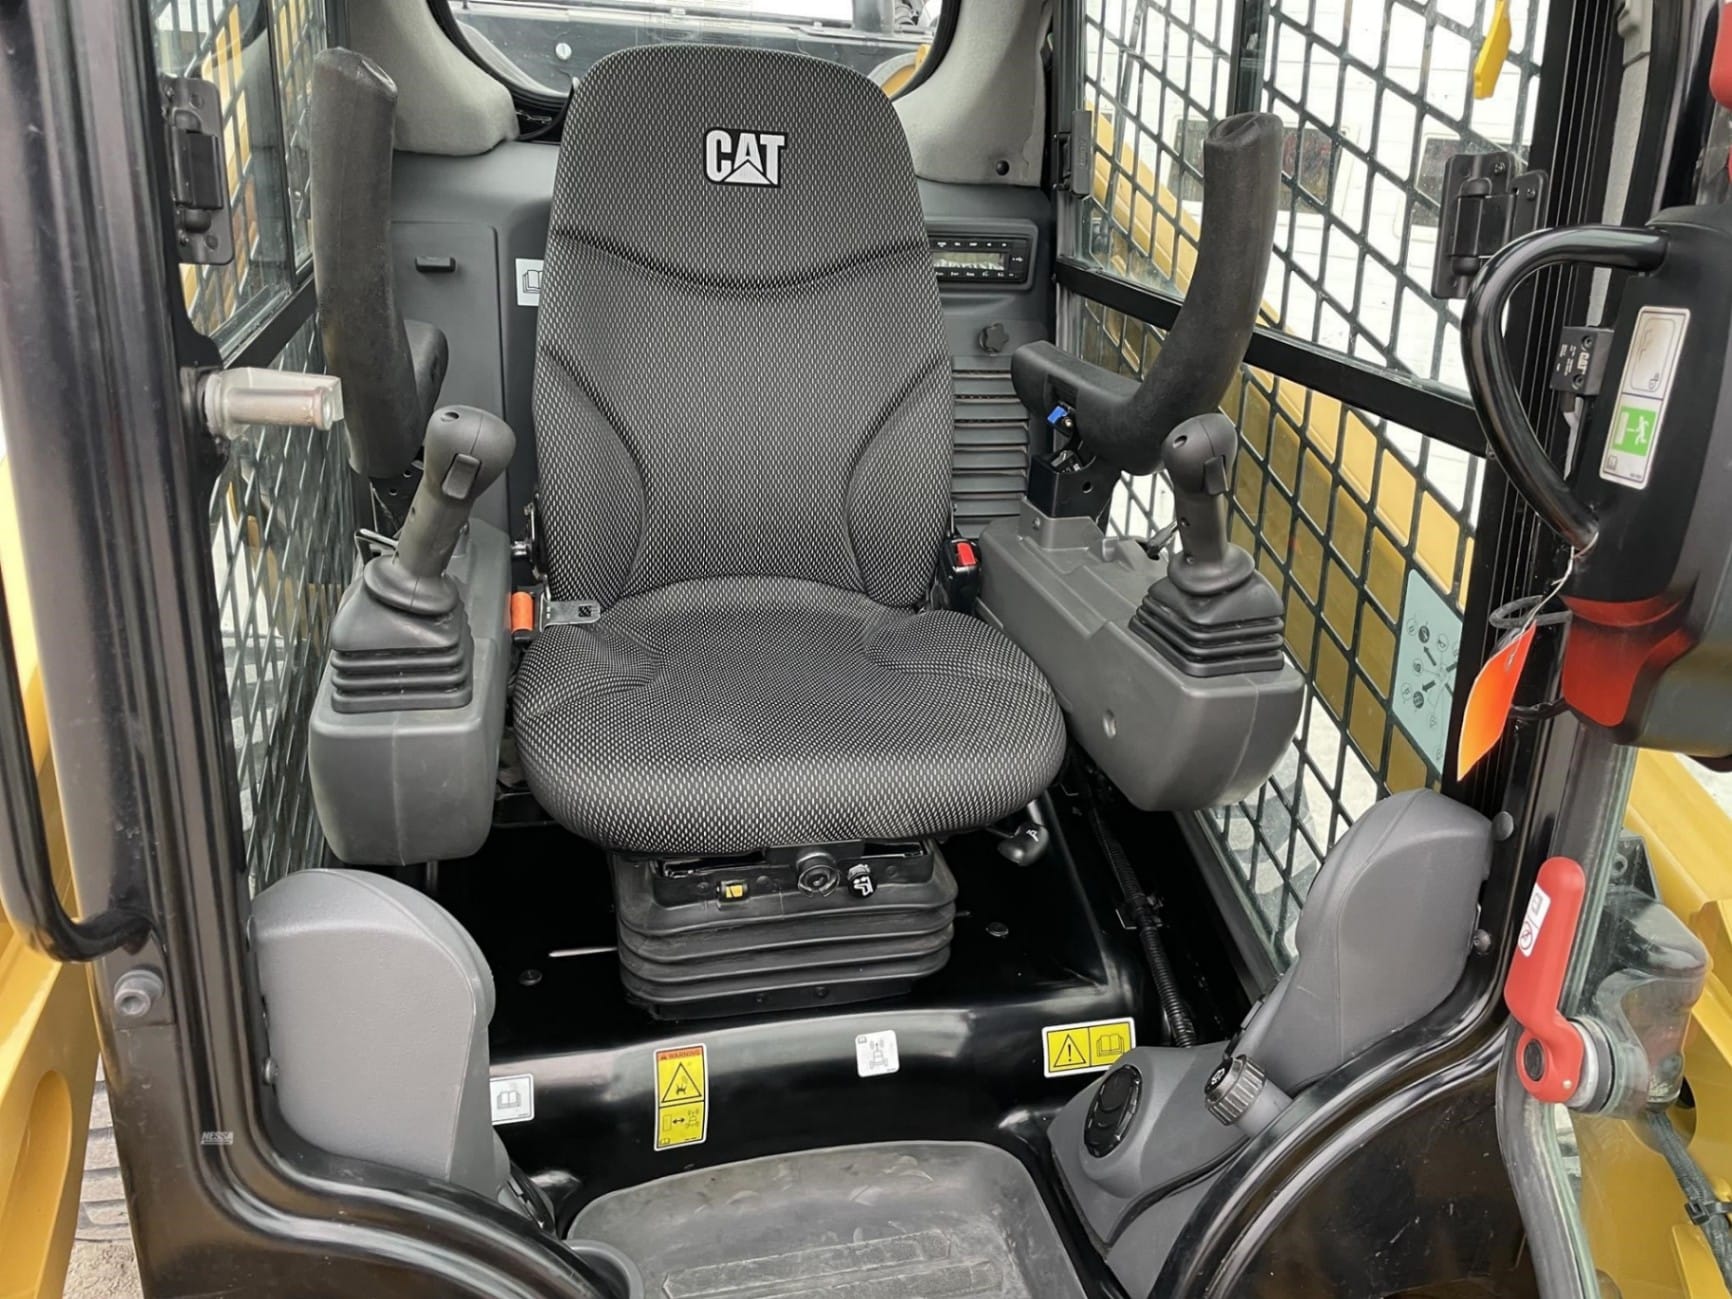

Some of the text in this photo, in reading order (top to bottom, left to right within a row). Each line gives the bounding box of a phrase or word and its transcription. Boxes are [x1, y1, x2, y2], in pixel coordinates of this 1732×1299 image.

[706, 129, 785, 185] CAT
[1577, 352, 1590, 375] CAT
[668, 1049, 700, 1059] WARNING
